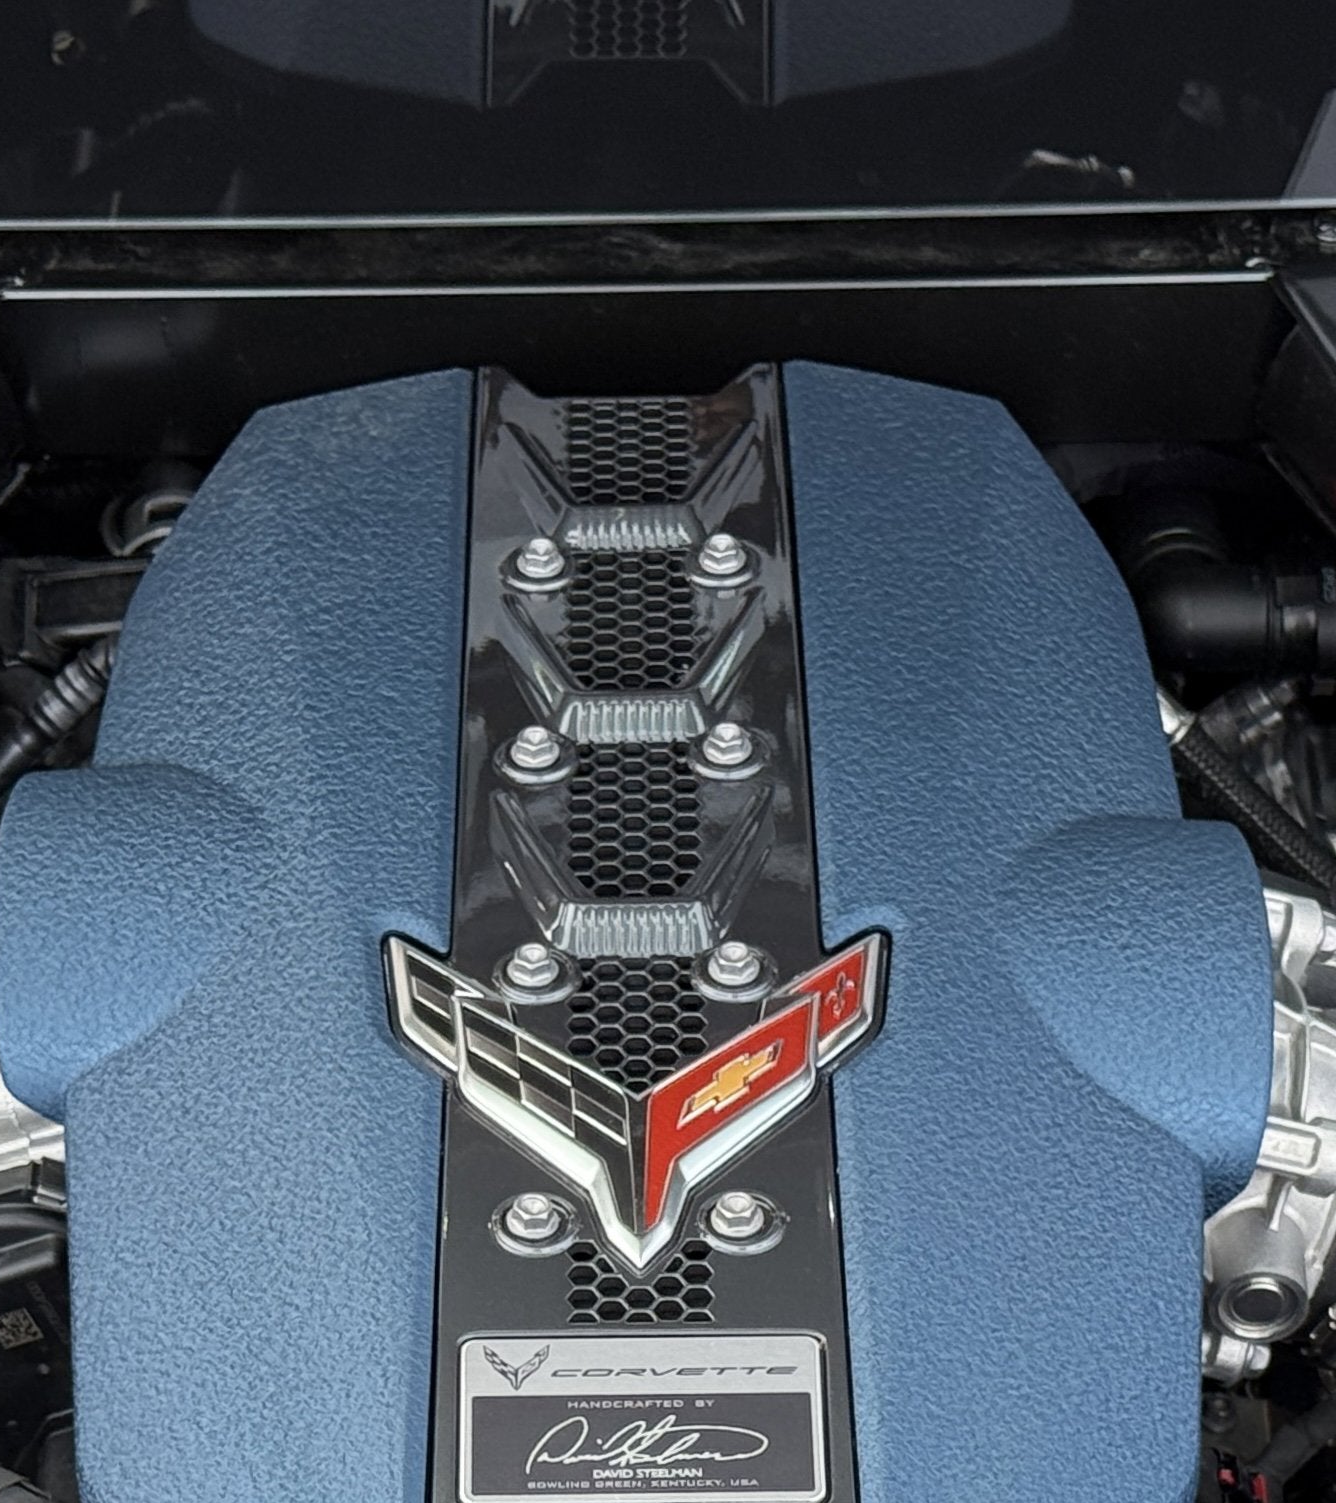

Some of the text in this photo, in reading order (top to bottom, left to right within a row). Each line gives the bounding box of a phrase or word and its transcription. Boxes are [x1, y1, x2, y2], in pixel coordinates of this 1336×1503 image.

[551, 1366, 798, 1377] CORVETTE
[567, 1400, 715, 1409] HANDCRAFTED BY
[592, 1467, 703, 1479] DAVID STEELMAN
[527, 1479, 760, 1489] BOWLING GREEN, KENTUCKY, USA
